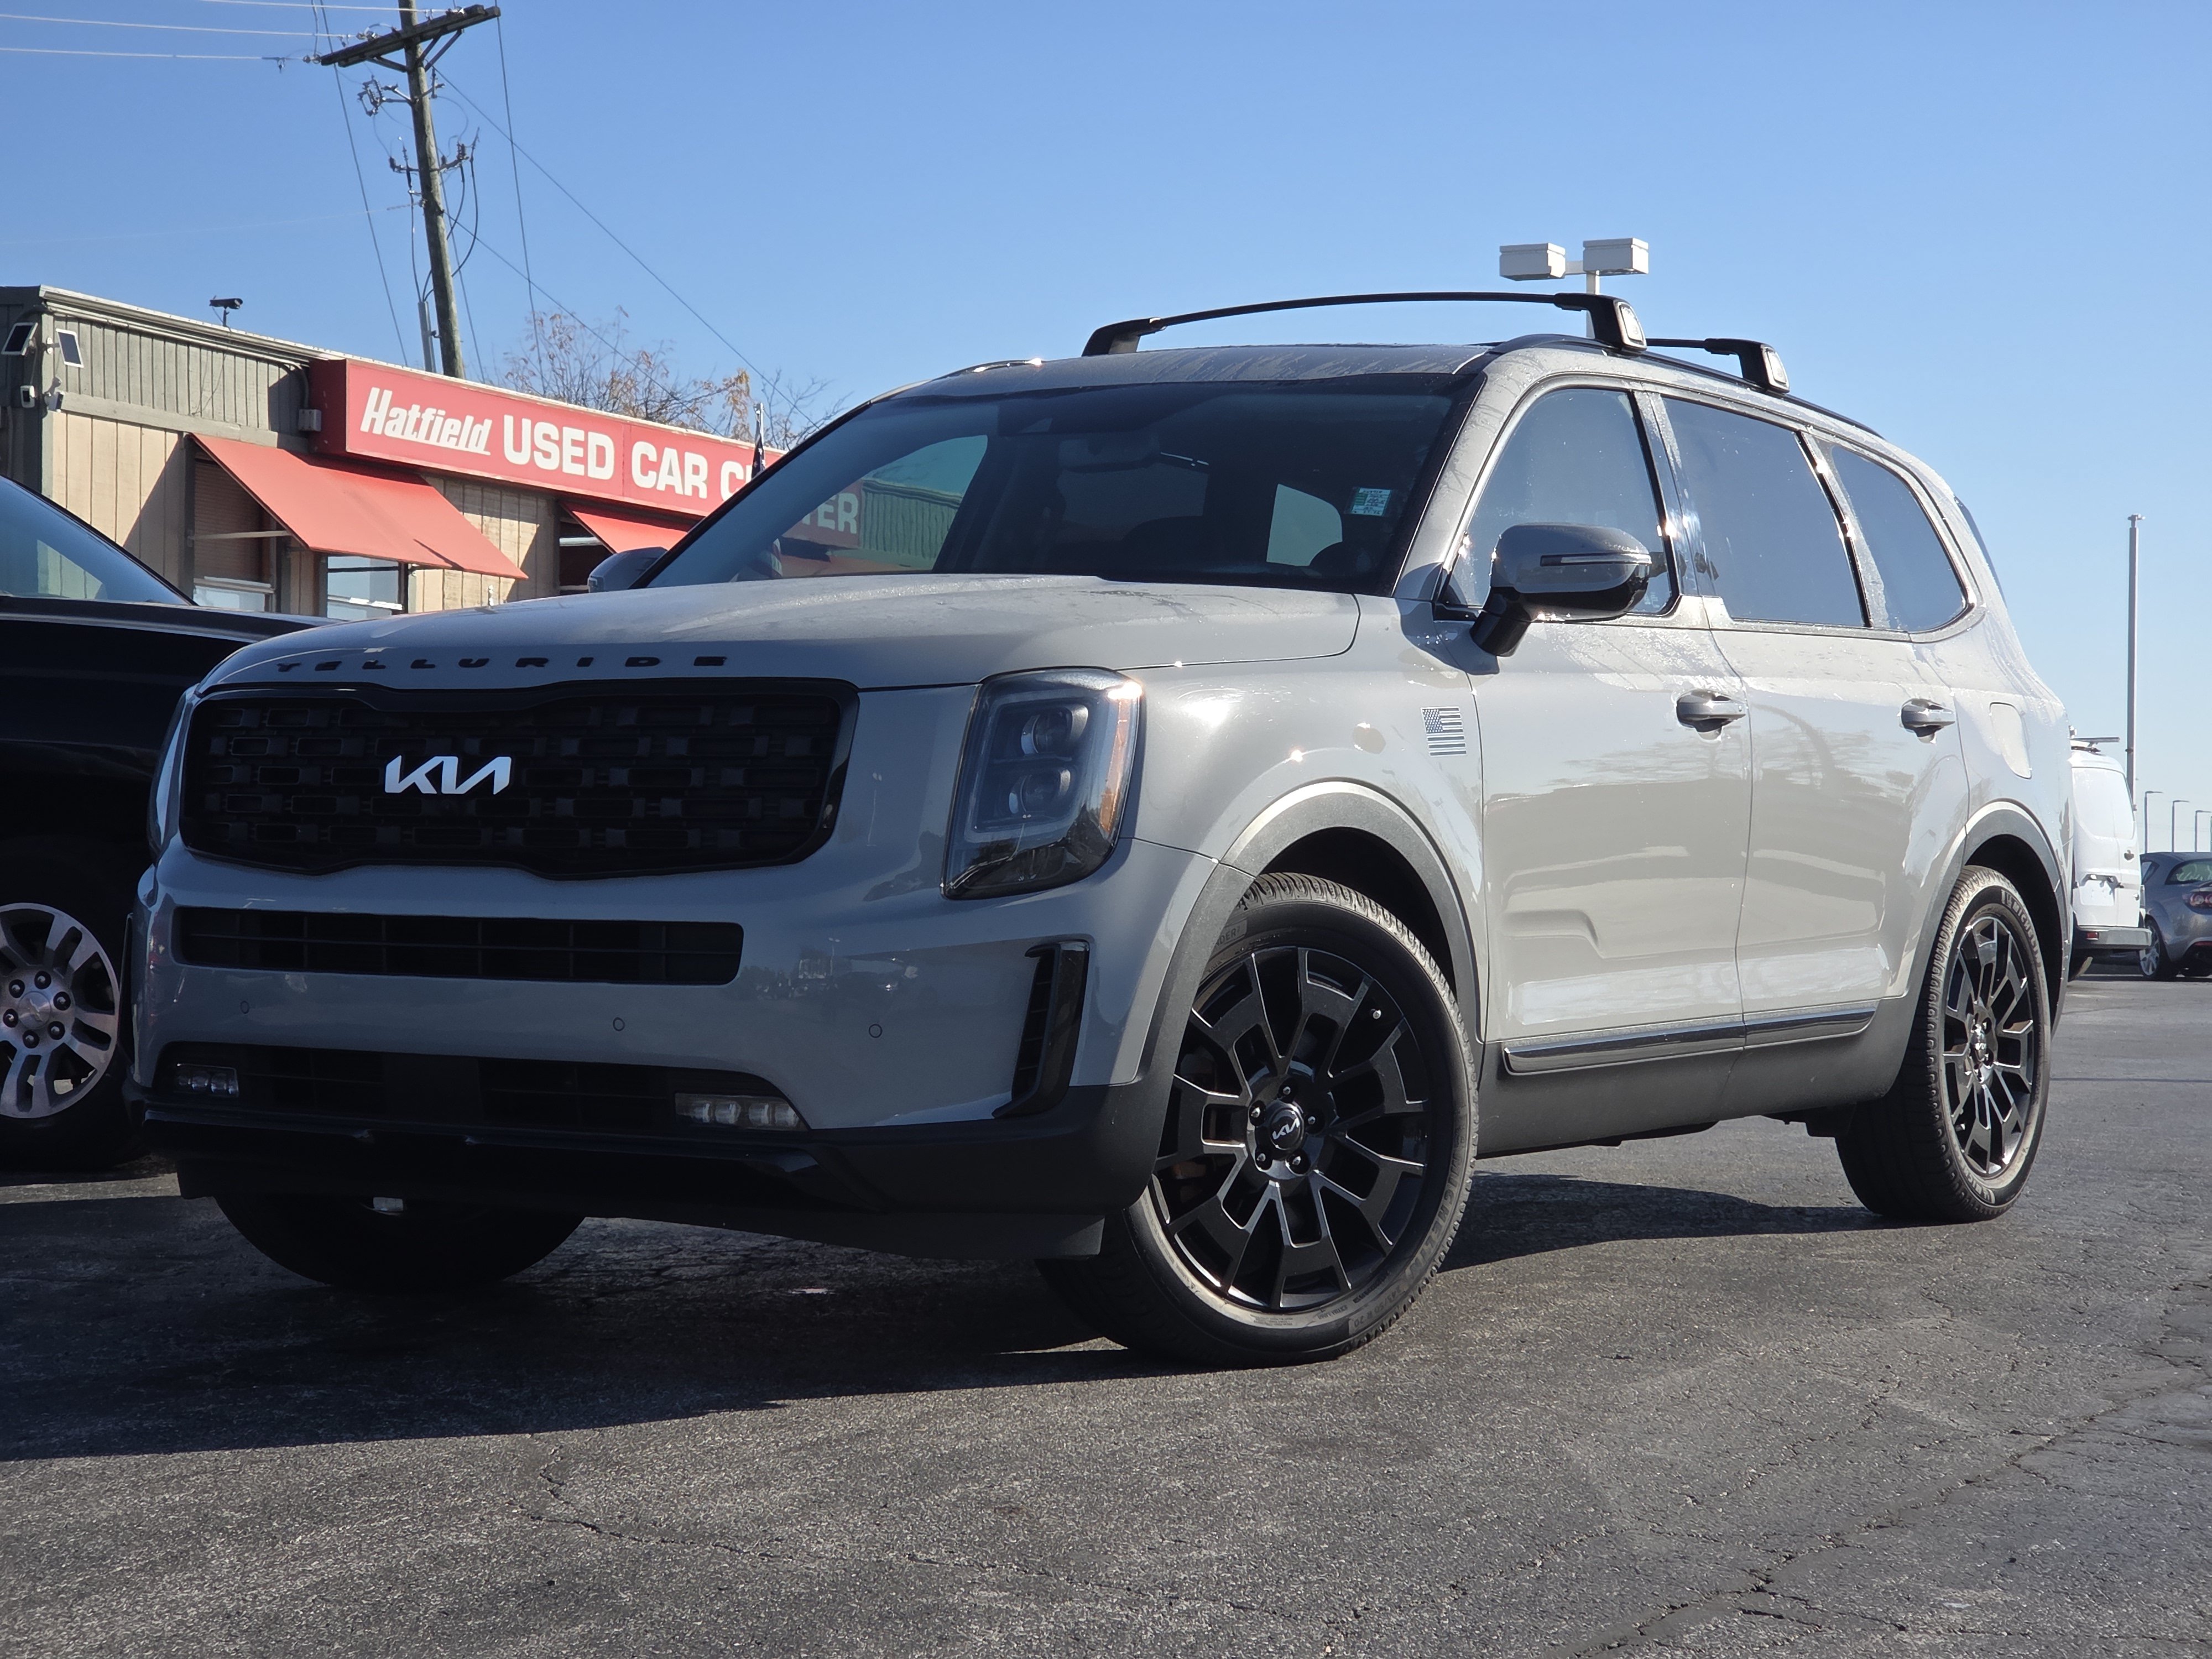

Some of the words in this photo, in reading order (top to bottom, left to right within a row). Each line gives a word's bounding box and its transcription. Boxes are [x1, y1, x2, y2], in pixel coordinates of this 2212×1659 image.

[360, 387, 492, 455] Hatfield
[504, 414, 614, 481] USED
[632, 441, 708, 499] CAR
[276, 656, 728, 672] TELLURIDE
[384, 755, 512, 794] KIA
